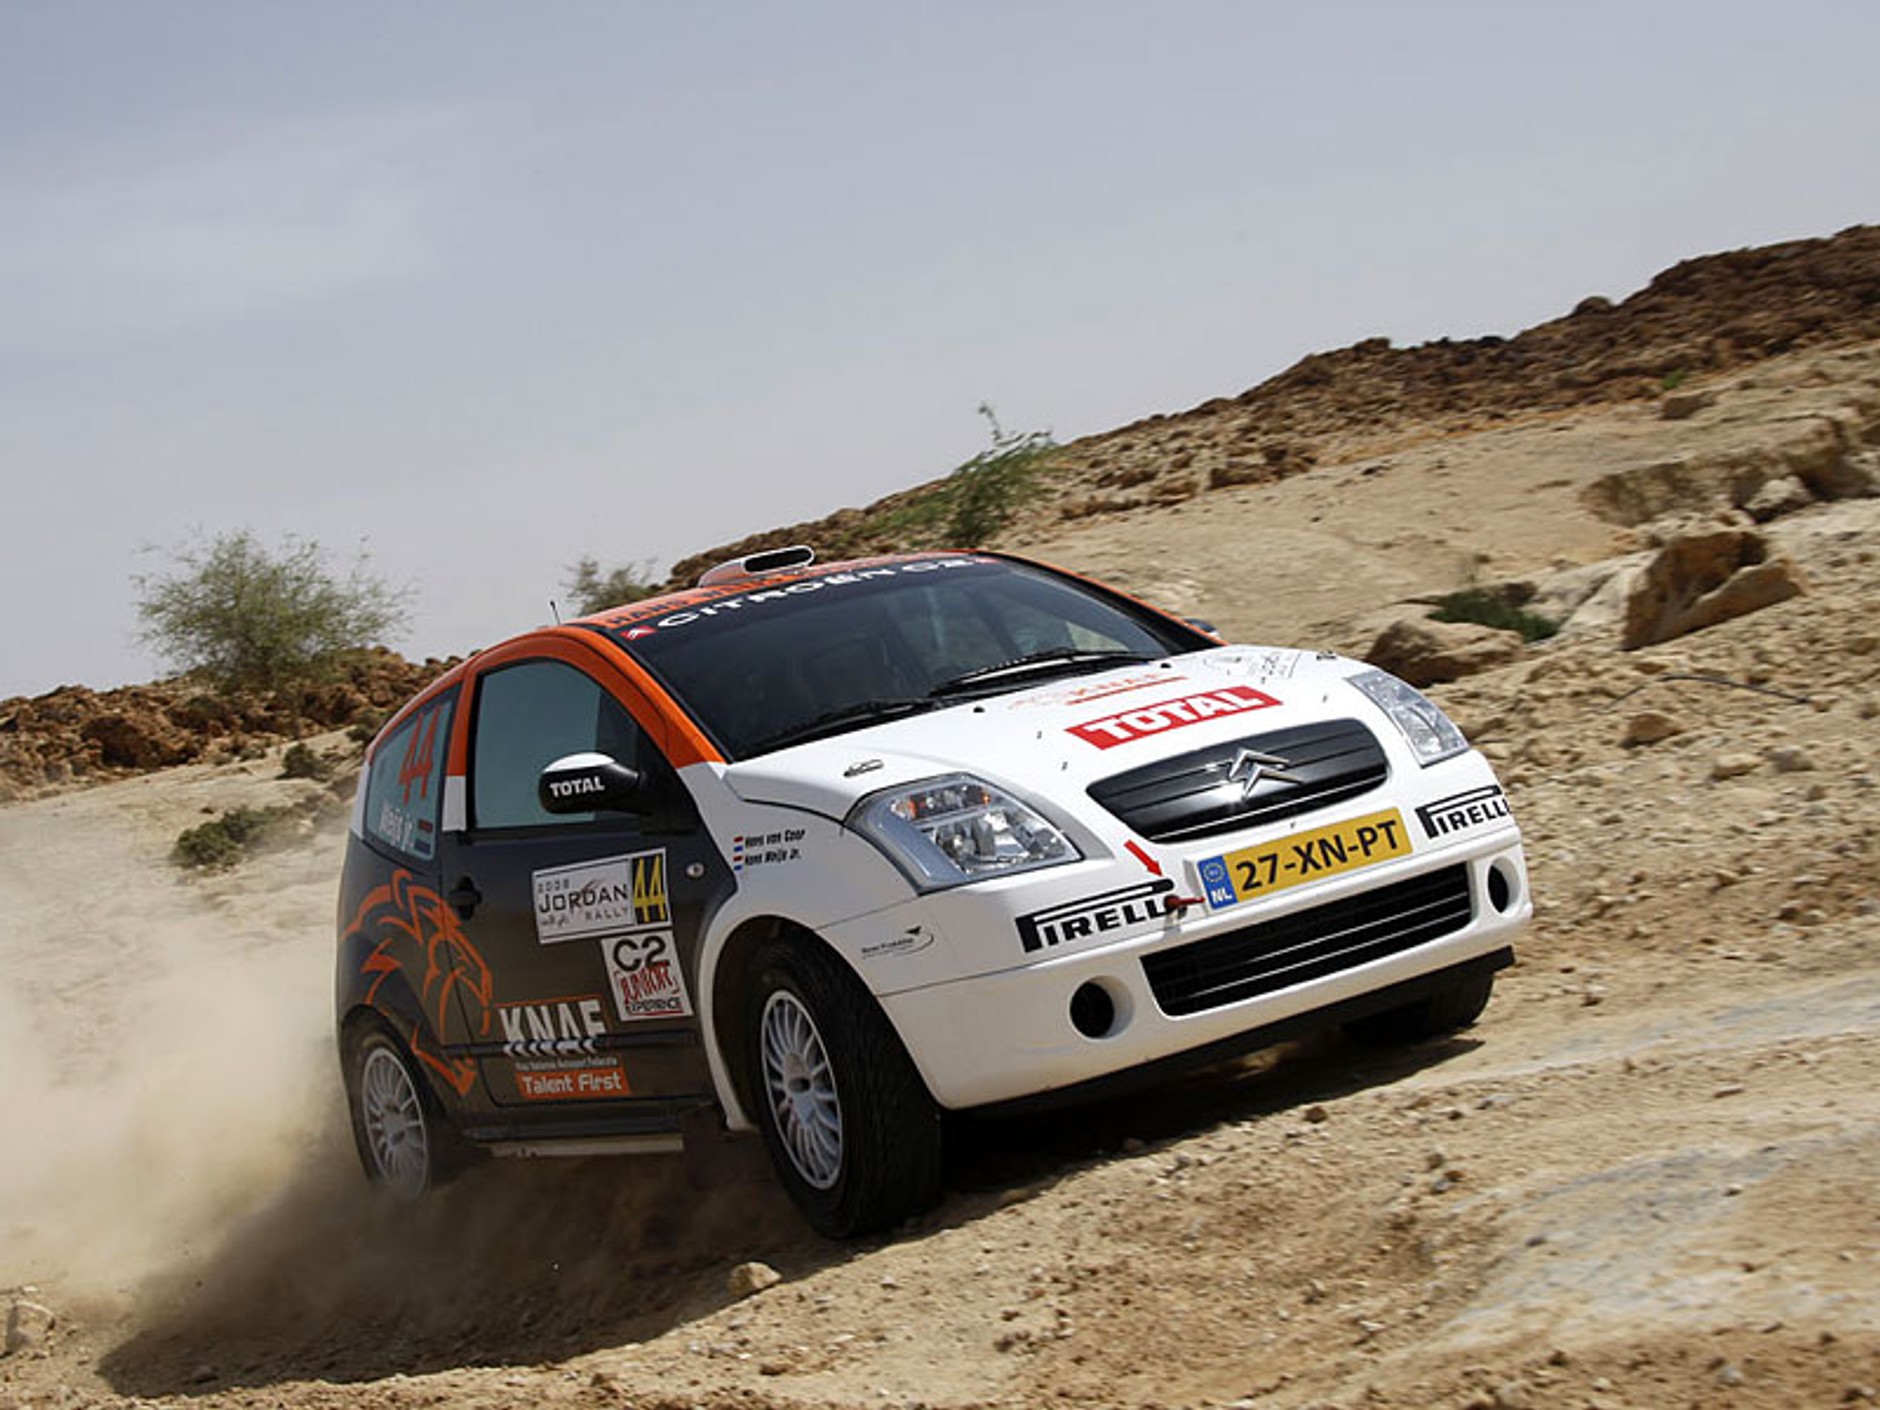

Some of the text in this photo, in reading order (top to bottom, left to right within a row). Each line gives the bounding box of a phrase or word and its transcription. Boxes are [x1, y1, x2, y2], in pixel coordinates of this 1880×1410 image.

[1081, 690, 1265, 740] TOTAL
[398, 704, 441, 806] 44
[549, 776, 605, 798] TOTAL
[1236, 819, 1397, 891] 27-XN-PT
[538, 884, 628, 913] JORDAN
[633, 855, 667, 923] 44
[1211, 887, 1233, 903] NL
[584, 907, 628, 922] RALLY
[613, 935, 670, 972] C2
[521, 1071, 622, 1094] Talent First
